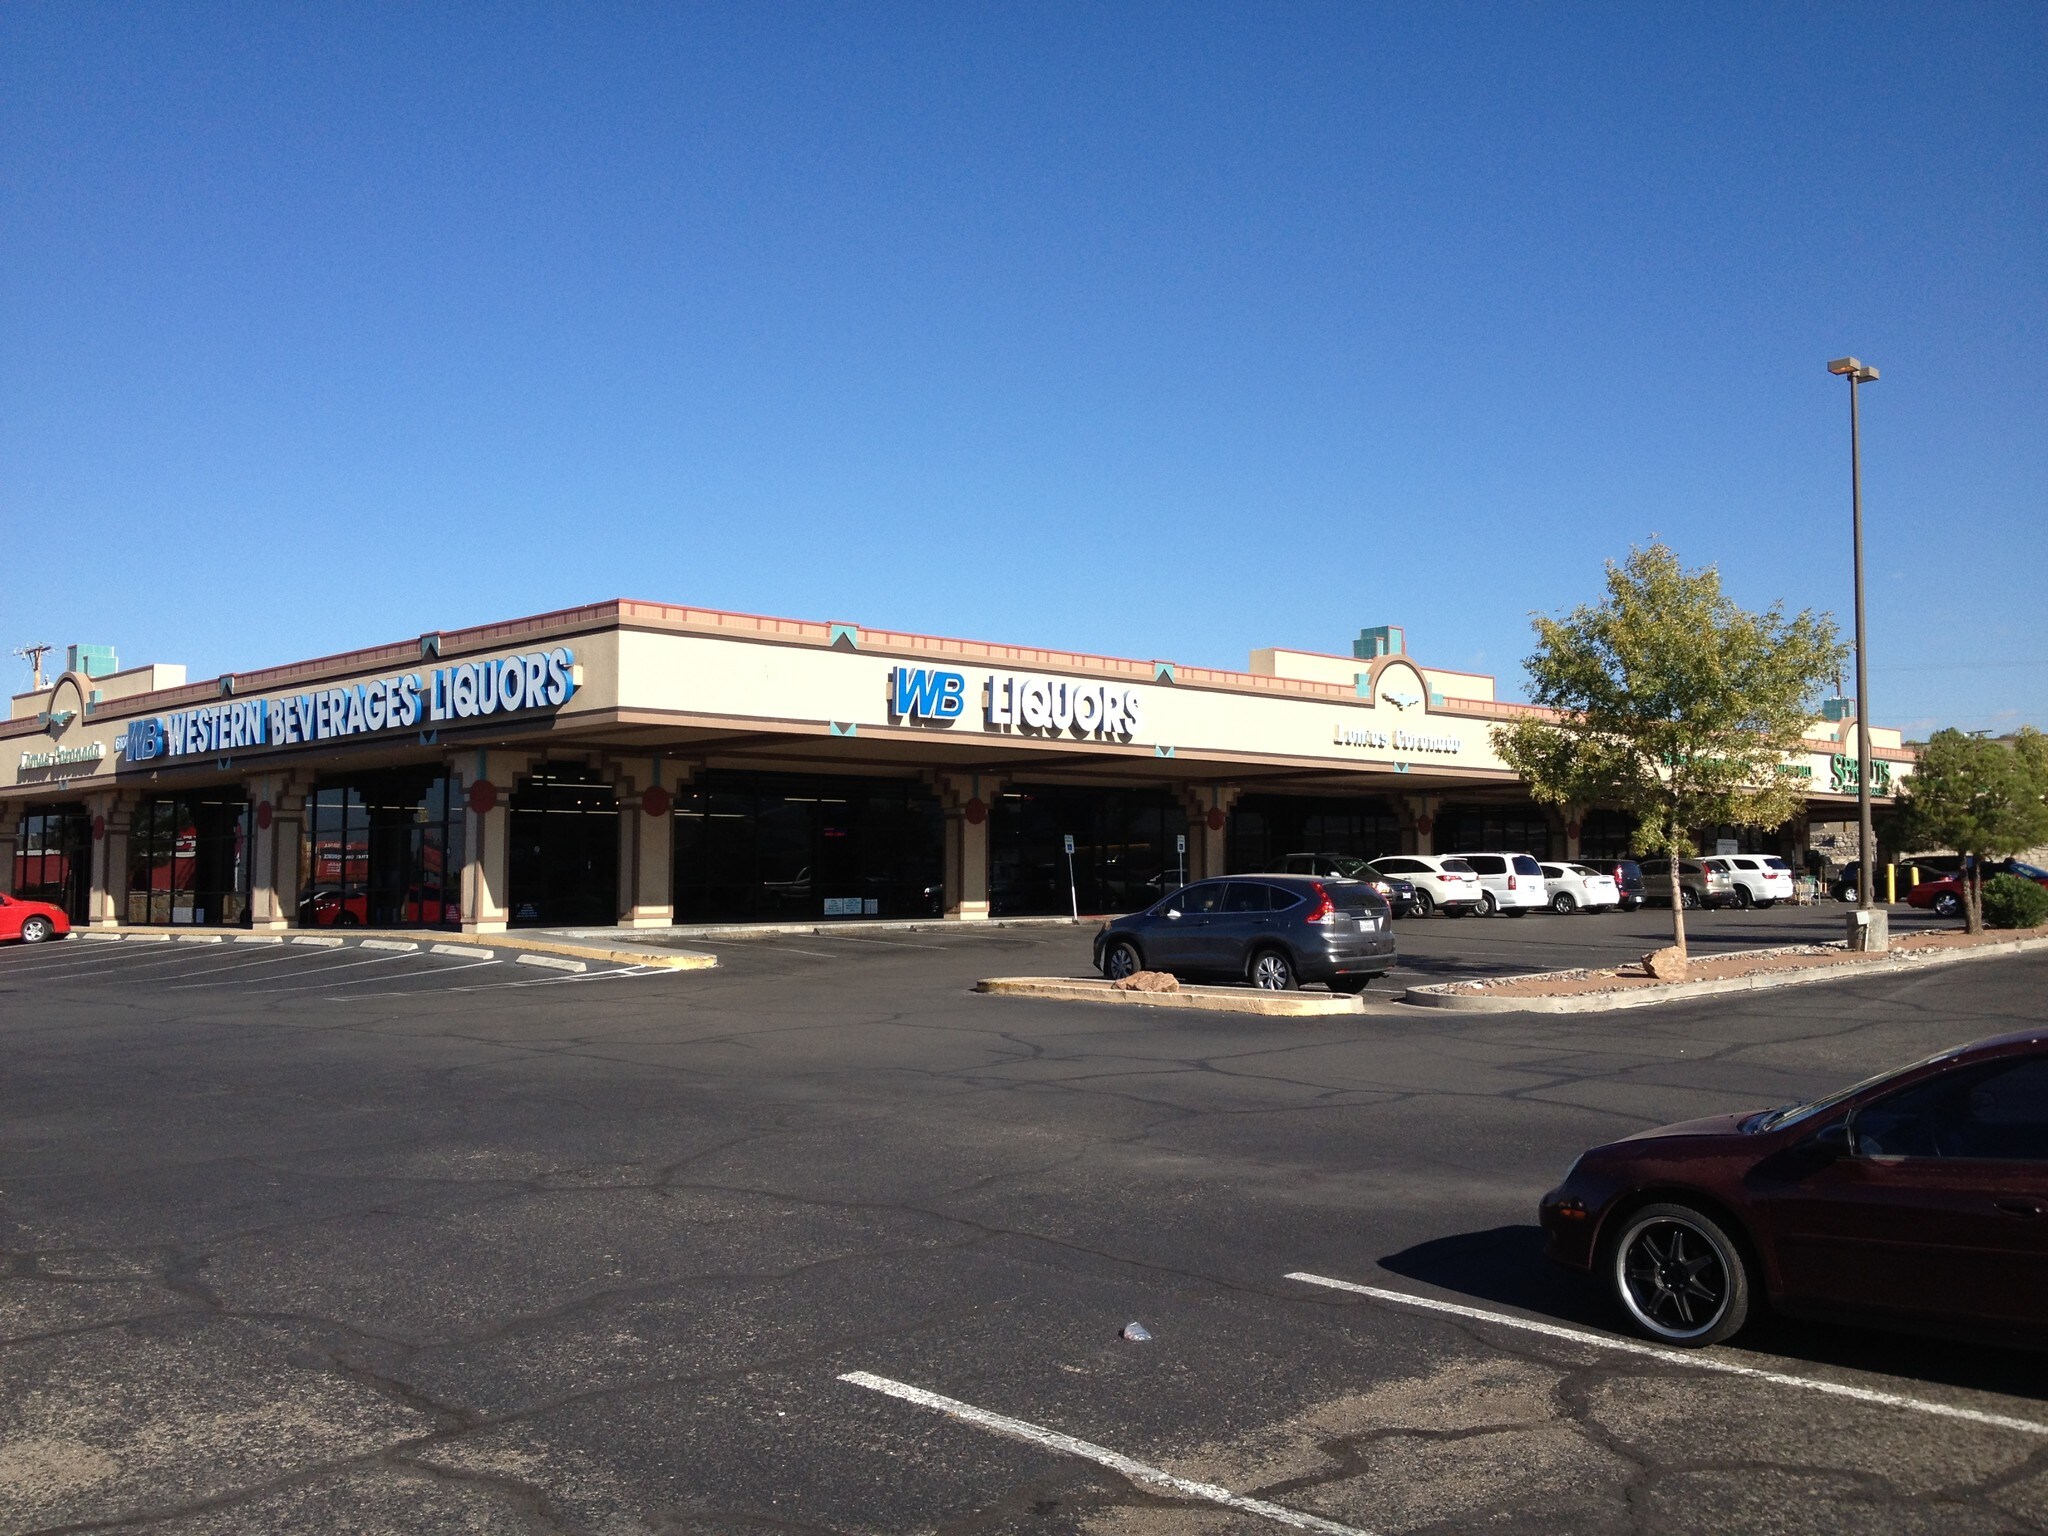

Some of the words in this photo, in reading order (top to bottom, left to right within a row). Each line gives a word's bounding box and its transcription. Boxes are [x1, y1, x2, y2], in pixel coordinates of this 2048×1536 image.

[126, 717, 164, 762] WB
[167, 699, 267, 756] WESTERN
[270, 673, 423, 746] BEVERAGES
[430, 647, 574, 721] LIQUORS
[891, 666, 965, 719] WB
[987, 675, 1142, 736] LIQUORS
